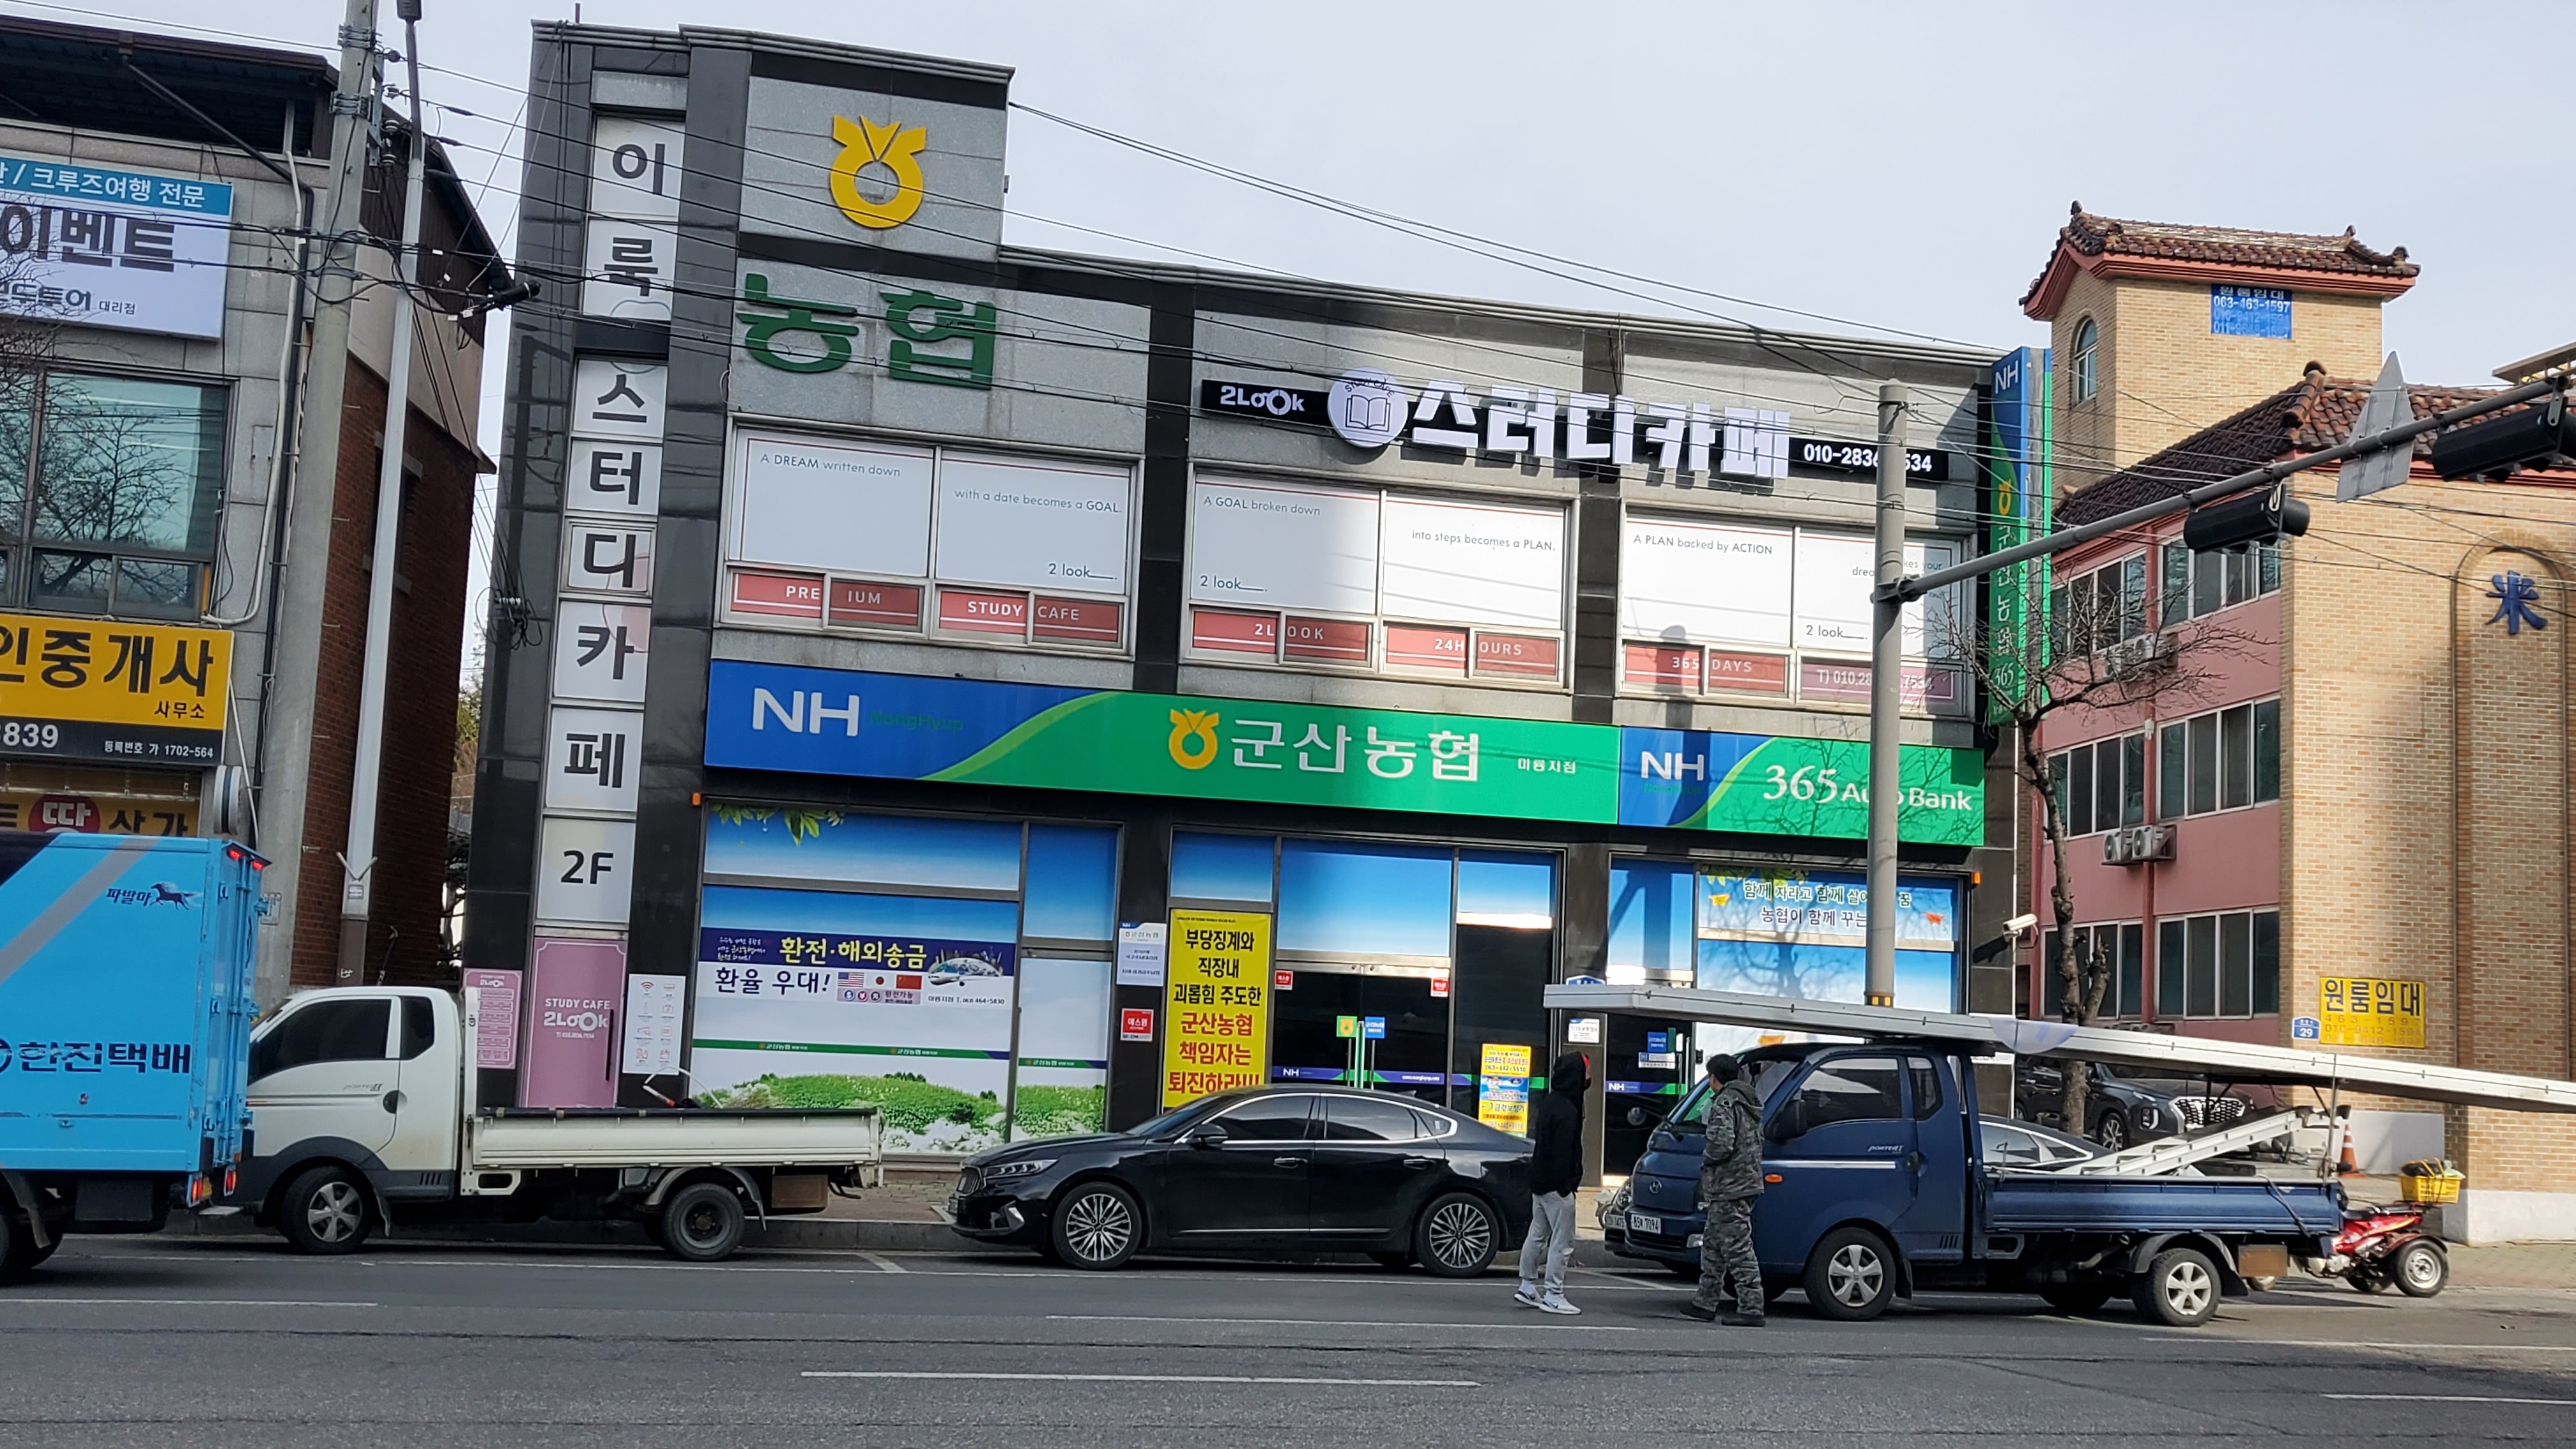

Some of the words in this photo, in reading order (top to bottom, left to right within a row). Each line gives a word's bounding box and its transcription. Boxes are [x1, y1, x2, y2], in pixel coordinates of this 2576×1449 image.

[30, 167, 151, 200] 크루즈여행
[159, 183, 205, 208] 전문
[1, 204, 174, 272] 이벤트
[99, 301, 135, 315] 대리점
[2213, 296, 2291, 313] 063-463-1597
[735, 273, 997, 390] 농협
[1995, 360, 2019, 395] NH
[1411, 378, 1790, 479] 스터디카페
[760, 453, 770, 464] A
[774, 454, 819, 470] DREAM
[822, 459, 865, 474] written
[868, 464, 901, 478] down
[954, 487, 979, 501] with
[983, 493, 991, 502] a
[993, 491, 1020, 505] date
[1023, 493, 1072, 509] becomes
[1075, 501, 1083, 510] a
[1086, 500, 1123, 514] GOAL.
[1204, 496, 1213, 507] A
[1215, 496, 1248, 510] GOAL
[1251, 499, 1288, 514] broken
[1291, 502, 1321, 516] down
[1411, 529, 1432, 541] into
[1434, 532, 1462, 546] steps
[1464, 533, 1510, 548] becomes
[1513, 540, 1520, 549] a
[1523, 539, 1556, 551] PLAN.
[1634, 534, 1641, 544] A
[1645, 535, 1674, 547] PLAN
[1677, 536, 1714, 550] backed
[1717, 540, 1730, 554] by
[1731, 541, 1773, 555] ACTION
[1048, 562, 1057, 576] 2
[1200, 575, 1209, 588] 2
[967, 601, 1023, 617] STUDY
[1037, 605, 1080, 621] CAFE
[1805, 624, 1814, 636] 2
[1672, 656, 1700, 670] 365
[1712, 659, 1752, 673] DAYS
[1817, 668, 1830, 684] T)
[1994, 662, 2014, 686] 365
[154, 700, 206, 719] 사무소
[752, 687, 860, 737] NH
[869, 710, 964, 732] NongHyup
[0, 722, 59, 748] 839
[104, 740, 143, 755] 등록번호
[149, 743, 159, 756] 가
[164, 744, 214, 758] 1702-564
[1230, 718, 1480, 783] 군산농협
[1517, 756, 1577, 775] 미룡지점
[1640, 750, 1705, 781] NH
[1763, 765, 1838, 804] 365
[1841, 786, 1904, 806] Auo
[1908, 787, 1972, 811] Bank
[560, 849, 614, 885] 2F
[106, 887, 151, 906] 파발마
[1744, 880, 1772, 900] 함께
[1775, 884, 1813, 901] 자라고
[1816, 885, 1844, 905] 함께
[1899, 893, 1912, 908] 꿈
[1761, 907, 1803, 924] 농협이
[1808, 909, 1836, 927] 함께
[1841, 911, 1867, 929] 꾸는
[1185, 928, 1255, 952] 부당징계와
[1198, 957, 1239, 979] 직장내
[714, 966, 763, 995] 환율
[771, 970, 831, 996] 우대!
[544, 997, 580, 1009] STUDY
[582, 999, 611, 1009] CAFE
[1173, 983, 1215, 1006] 괴롭힘
[1220, 985, 1262, 1007] 주도한
[2324, 979, 2421, 1016] 원룸임대
[1180, 1011, 1254, 1037] 군산농협
[2325, 1014, 2421, 1026] 463-159
[2299, 1028, 2313, 1038] 29
[19, 1040, 192, 1075] 한진택배
[1179, 1041, 1252, 1066] 책임자는
[1282, 1068, 1299, 1077] NH
[1608, 1082, 1625, 1091] NH
